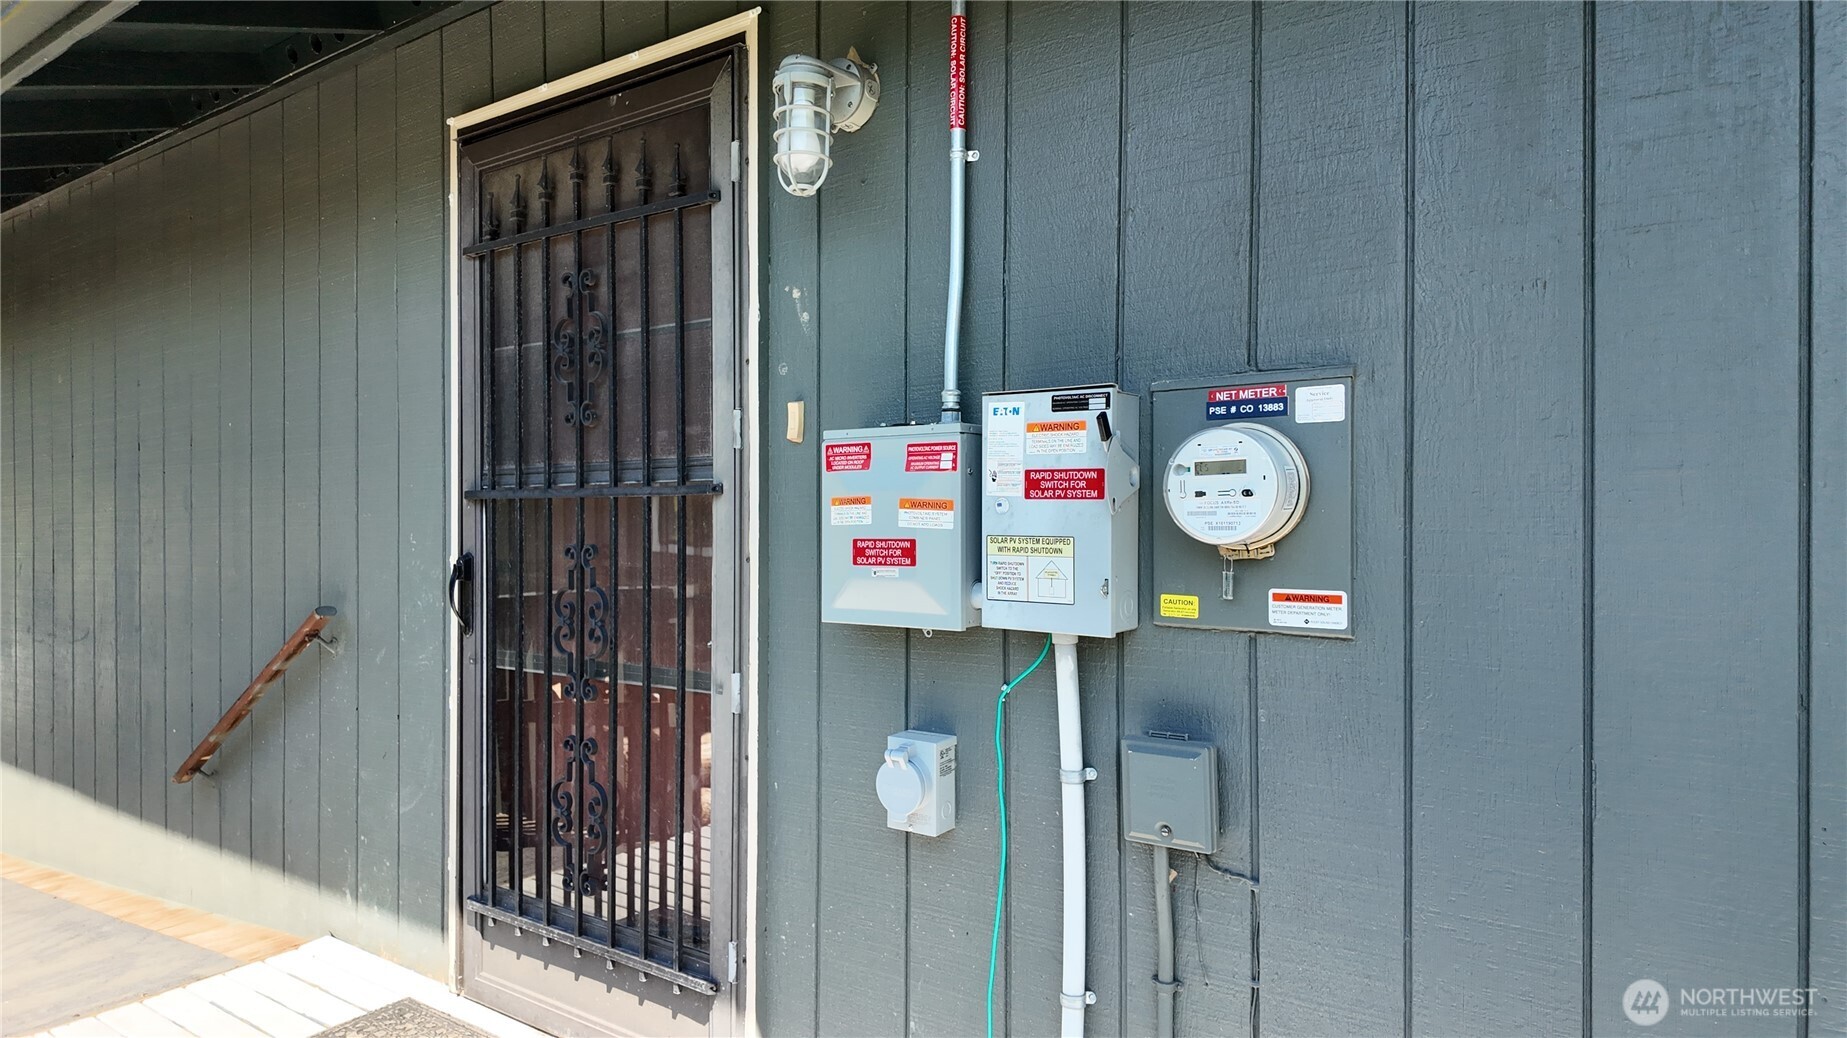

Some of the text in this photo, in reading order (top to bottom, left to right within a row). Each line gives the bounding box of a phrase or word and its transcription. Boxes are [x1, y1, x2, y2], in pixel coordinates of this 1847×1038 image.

[958, 85, 966, 126] CAUTION:
[1216, 387, 1277, 401] NET METER
[1209, 406, 1227, 415] PSE
[1230, 405, 1237, 414] #
[1240, 404, 1254, 413] CO
[1040, 422, 1080, 432] WARNING
[833, 445, 863, 453] WARNING
[1030, 471, 1098, 480] RAPID SHUTDOWN
[1040, 480, 1087, 489] SWITCH FOR
[1029, 489, 1098, 498] SOLAR PV SYSTEM
[910, 501, 948, 510] WARNING
[1018, 537, 1041, 545] SYSTEM
[1041, 538, 1071, 546] EQUIPPED
[997, 545, 1063, 555] WITH RAPID SHUTDOWN
[1292, 594, 1330, 603] WARNING
